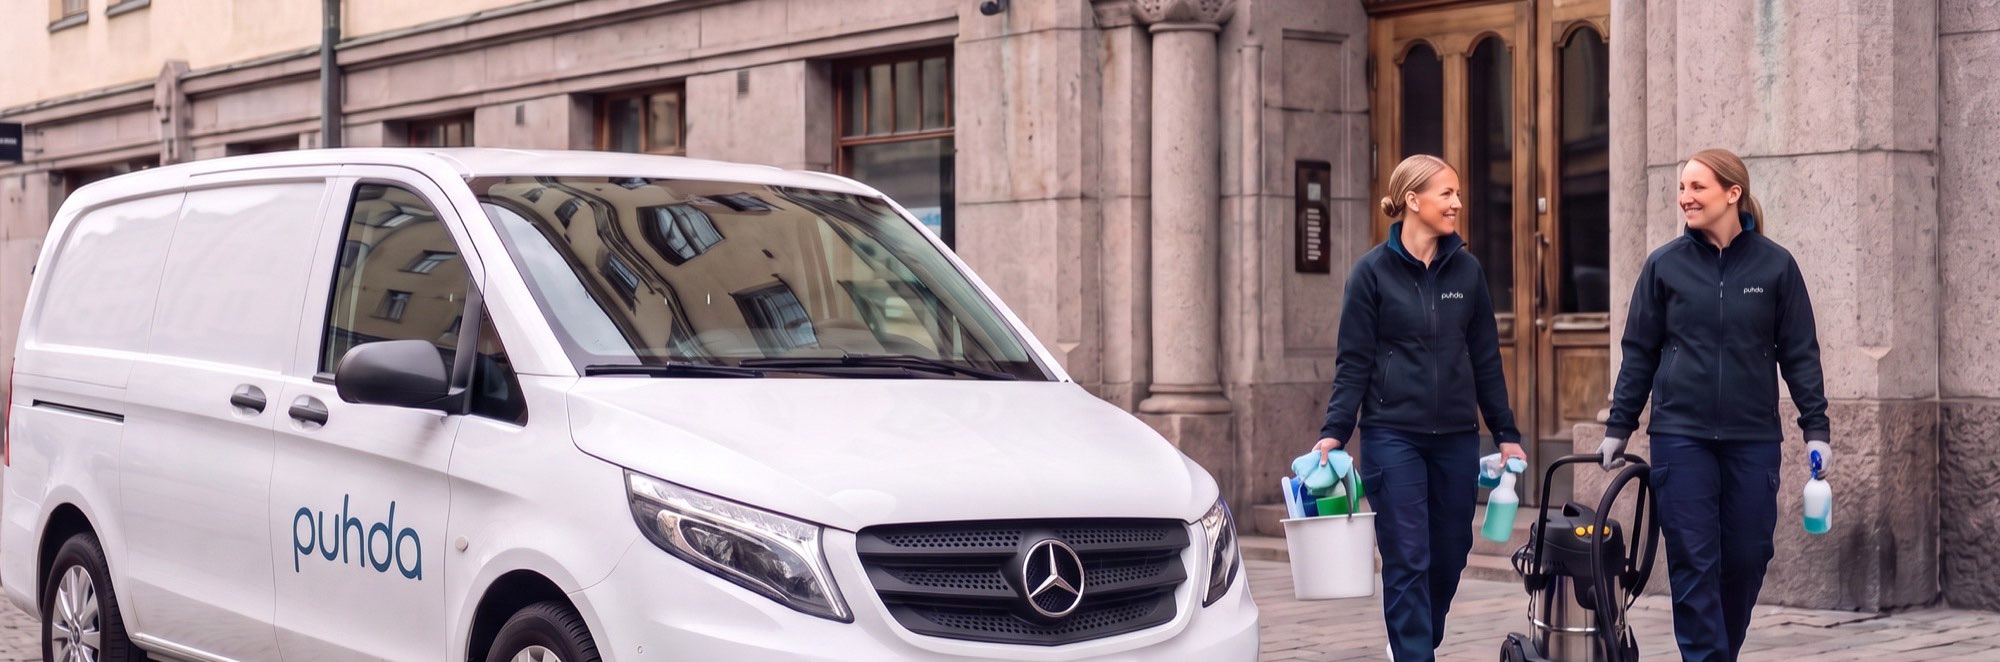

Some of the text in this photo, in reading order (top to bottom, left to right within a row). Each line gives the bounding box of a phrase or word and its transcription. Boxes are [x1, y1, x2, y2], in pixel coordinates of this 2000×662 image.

[1441, 290, 1464, 301] puhda
[1743, 285, 1764, 295] puhda
[293, 493, 422, 581] puhda
